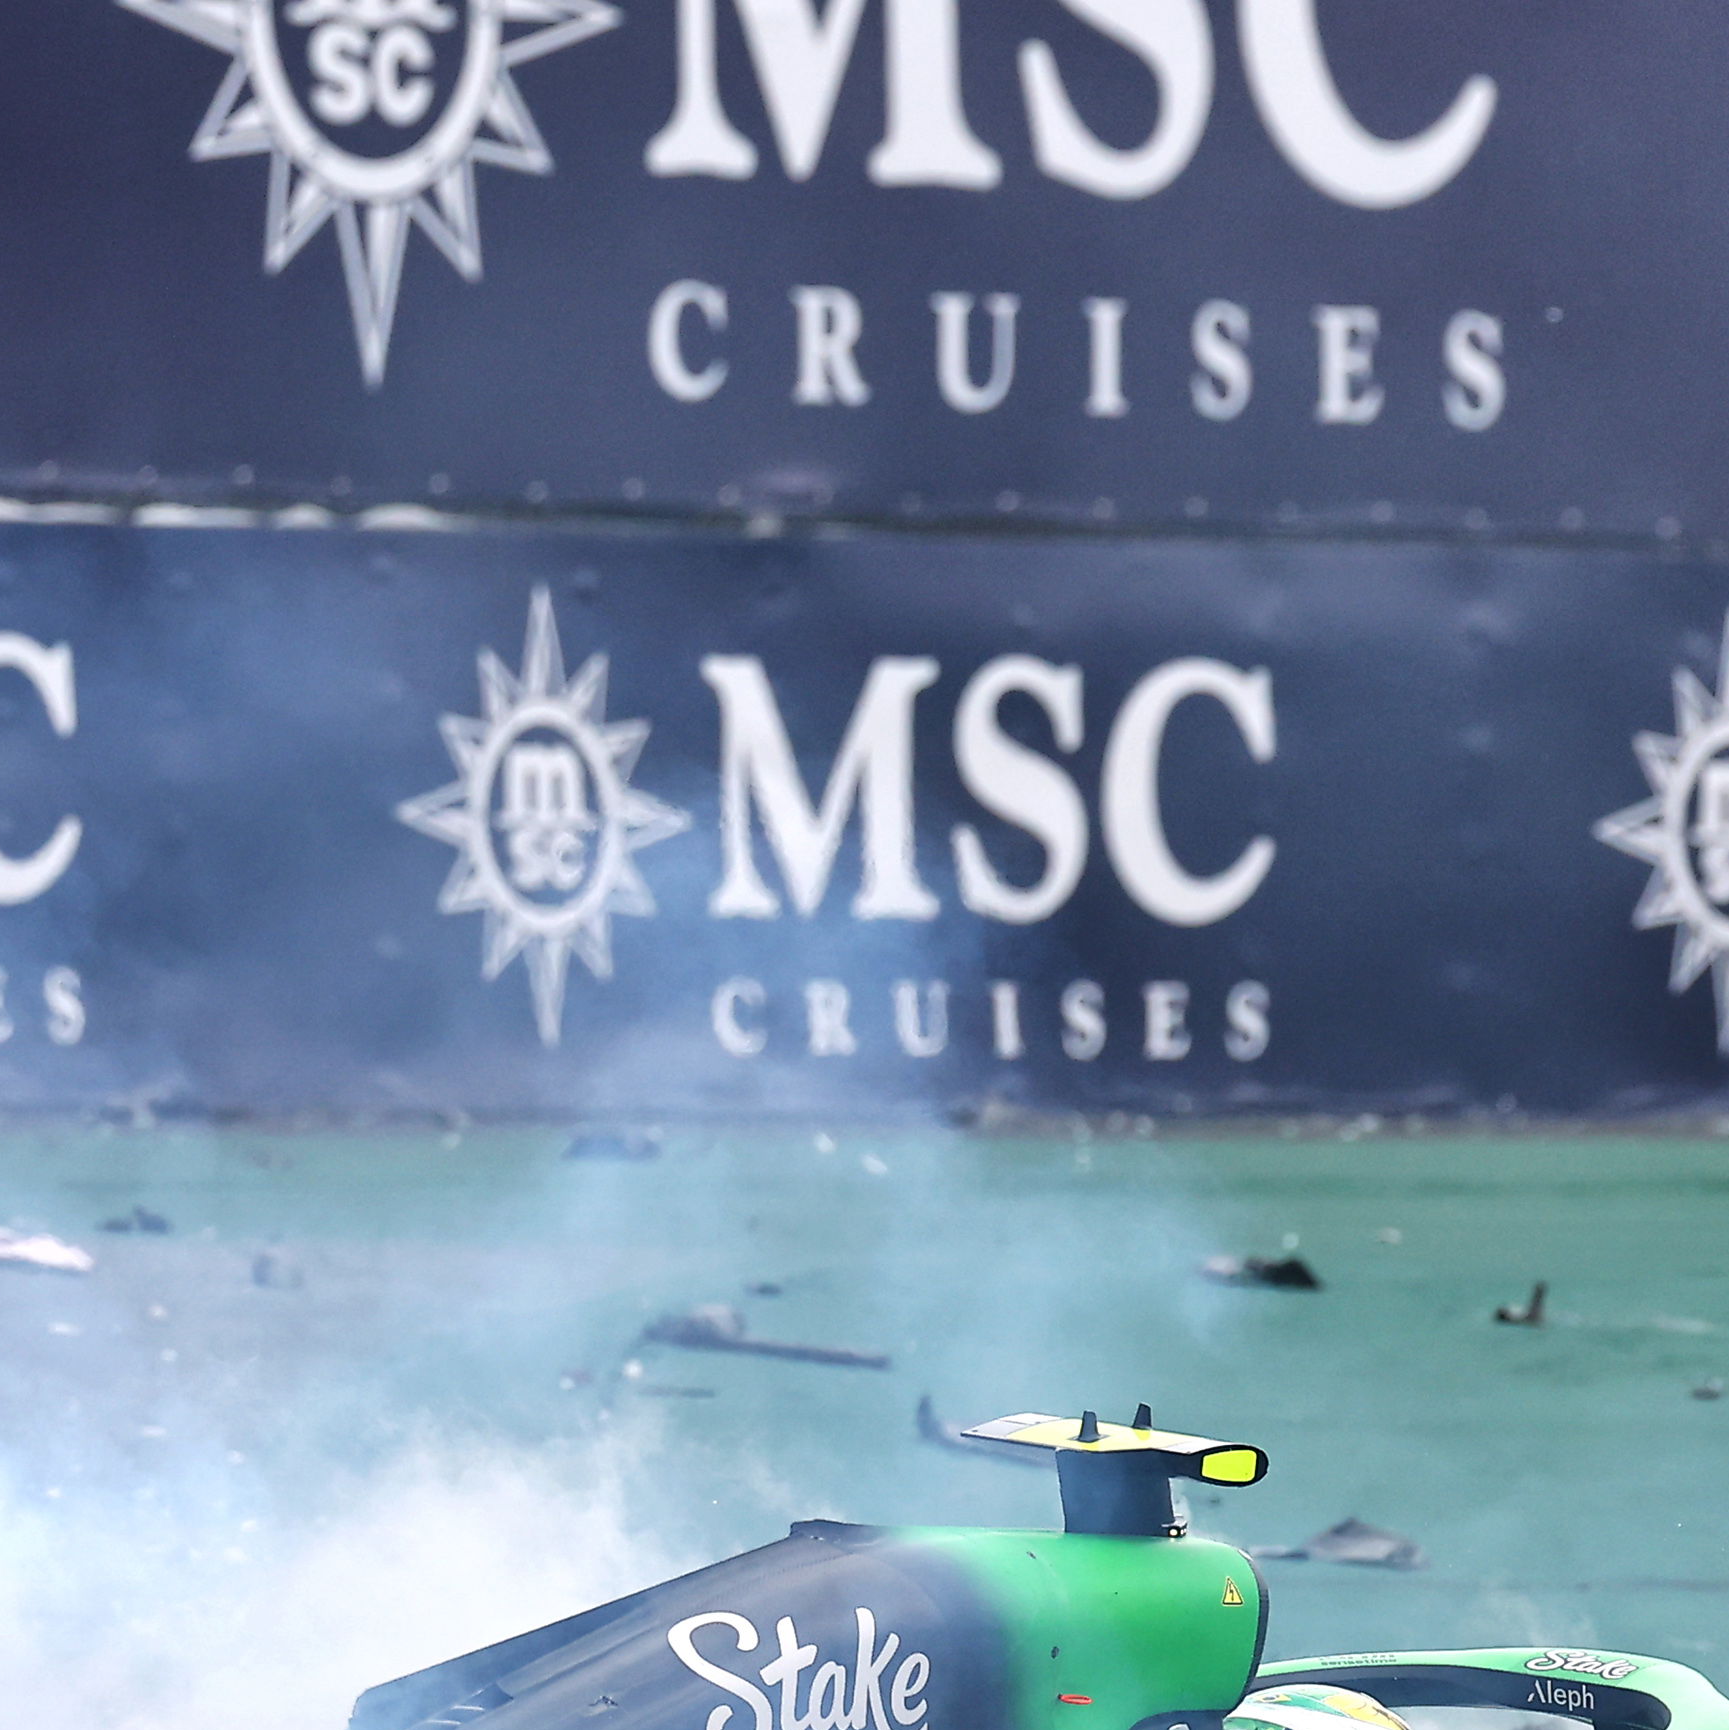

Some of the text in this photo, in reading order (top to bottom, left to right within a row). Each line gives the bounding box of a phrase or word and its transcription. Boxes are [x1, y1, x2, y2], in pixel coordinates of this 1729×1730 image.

[647, 0, 1498, 208] MSC
[647, 281, 1506, 430] CRUISES
[701, 655, 1275, 926] MSC
[710, 978, 1272, 1061] CRUISES
[1524, 1648, 1640, 1680] Stake
[1527, 1679, 1594, 1712] Aleph
